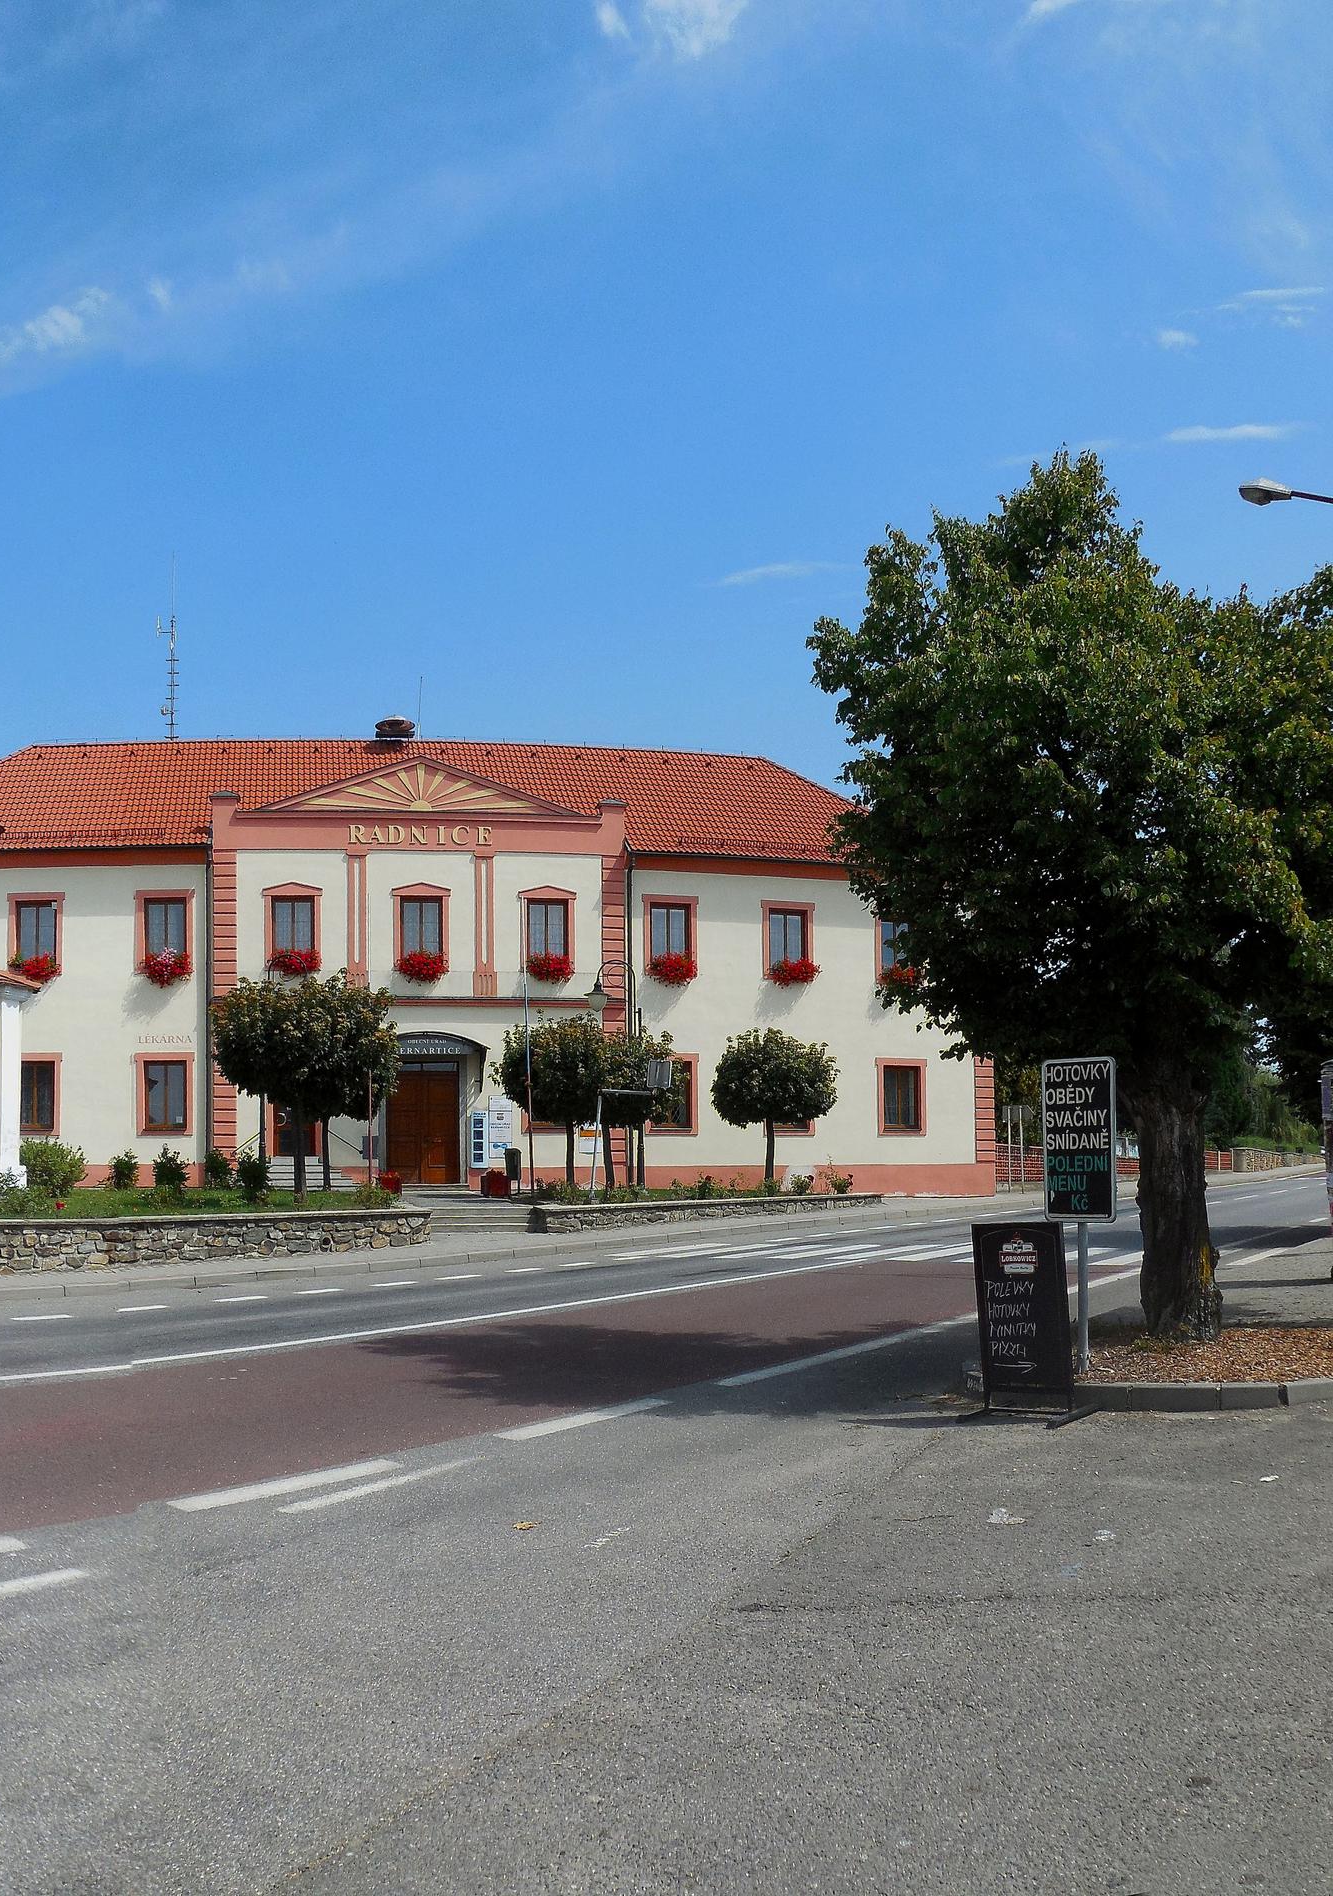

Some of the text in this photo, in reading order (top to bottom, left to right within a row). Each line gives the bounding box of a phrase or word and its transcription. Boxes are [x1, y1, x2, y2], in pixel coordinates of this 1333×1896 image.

[348, 824, 493, 846] RADNICE
[137, 1033, 193, 1044] LÉKÁRNA
[1045, 1063, 1110, 1082] HOTOVKY
[1045, 1084, 1095, 1105] OBĚDY
[1046, 1106, 1108, 1128] SVAČINY
[1046, 1128, 1110, 1150] SNÍDANĚ
[1047, 1151, 1109, 1172] POLEDNÍ
[1047, 1174, 1087, 1192] MENU
[1071, 1194, 1089, 1211] Kč
[1001, 1255, 1036, 1263] LOBKOWICZ
[987, 1301, 1030, 1320] HOTOVKY
[989, 1321, 1037, 1338] MINUTKY
